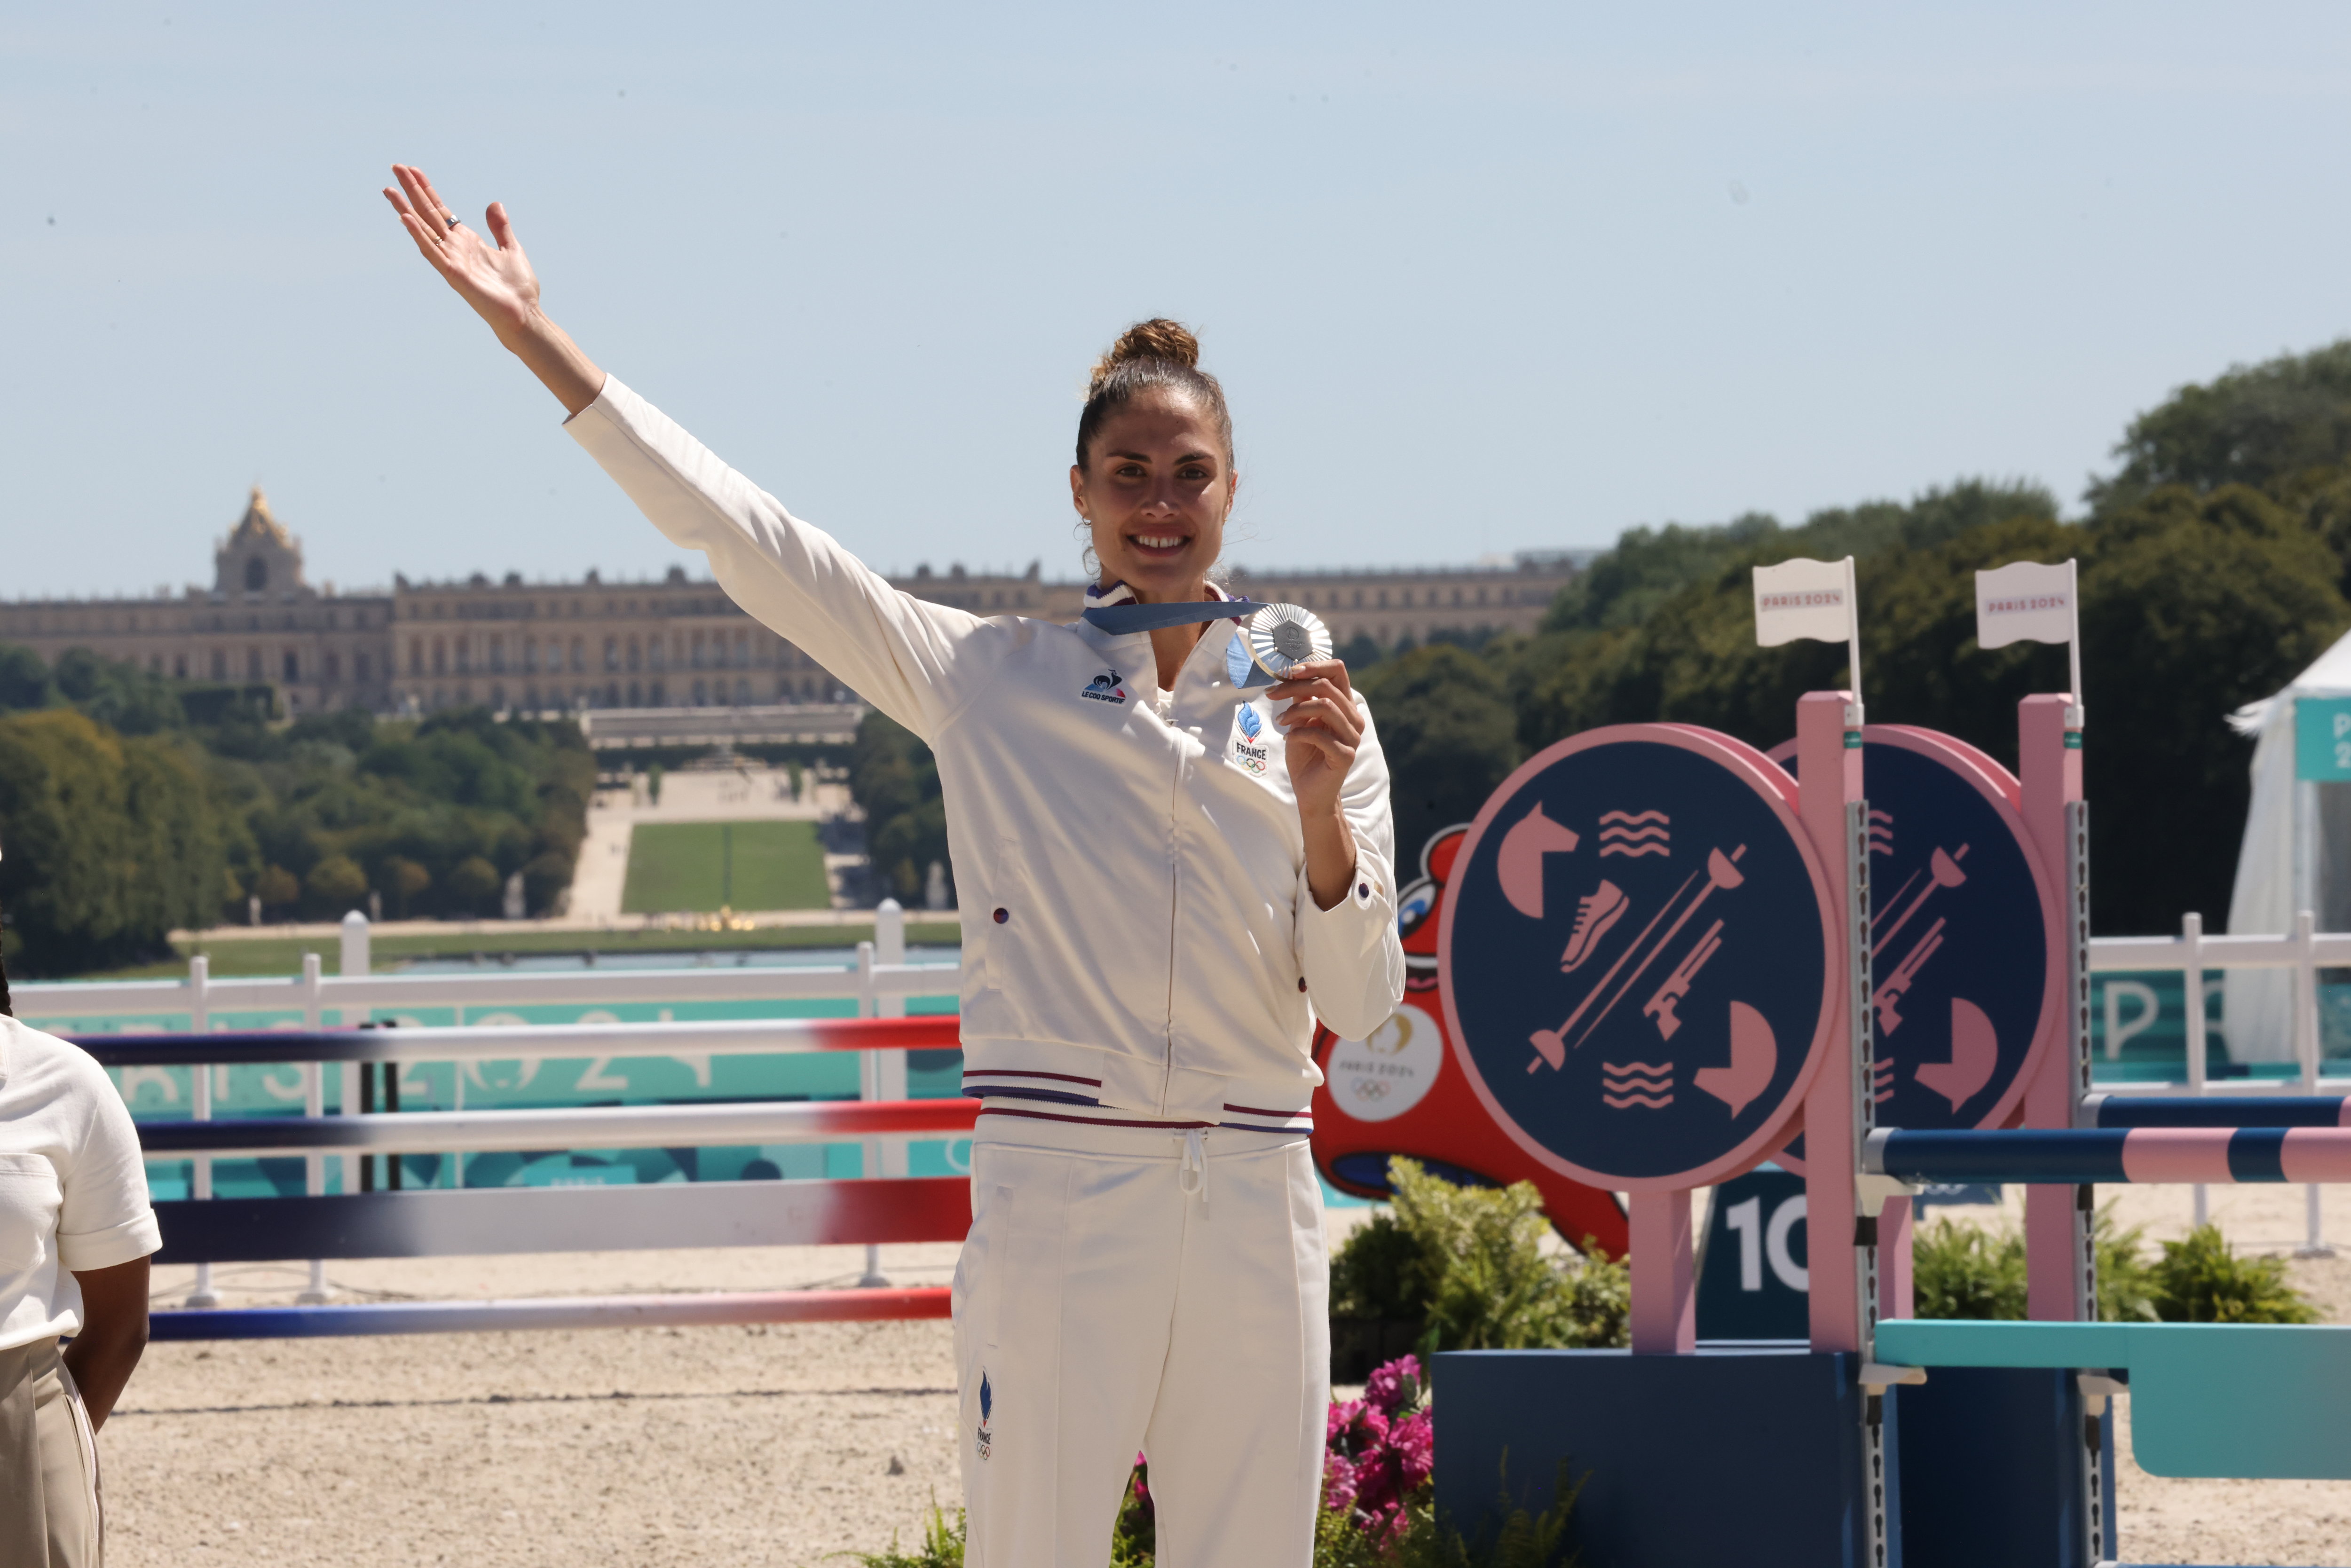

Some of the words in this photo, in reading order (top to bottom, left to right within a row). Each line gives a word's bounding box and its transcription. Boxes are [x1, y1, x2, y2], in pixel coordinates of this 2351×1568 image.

[1763, 595, 1801, 606] PARIS
[1805, 593, 1840, 605] 2024
[1989, 599, 2027, 612] PARIS
[2030, 597, 2065, 609] 2024
[1101, 694, 1125, 704] SPORTIF
[1237, 742, 1266, 760] FRANCE
[978, 1426, 991, 1444] FRANCE
